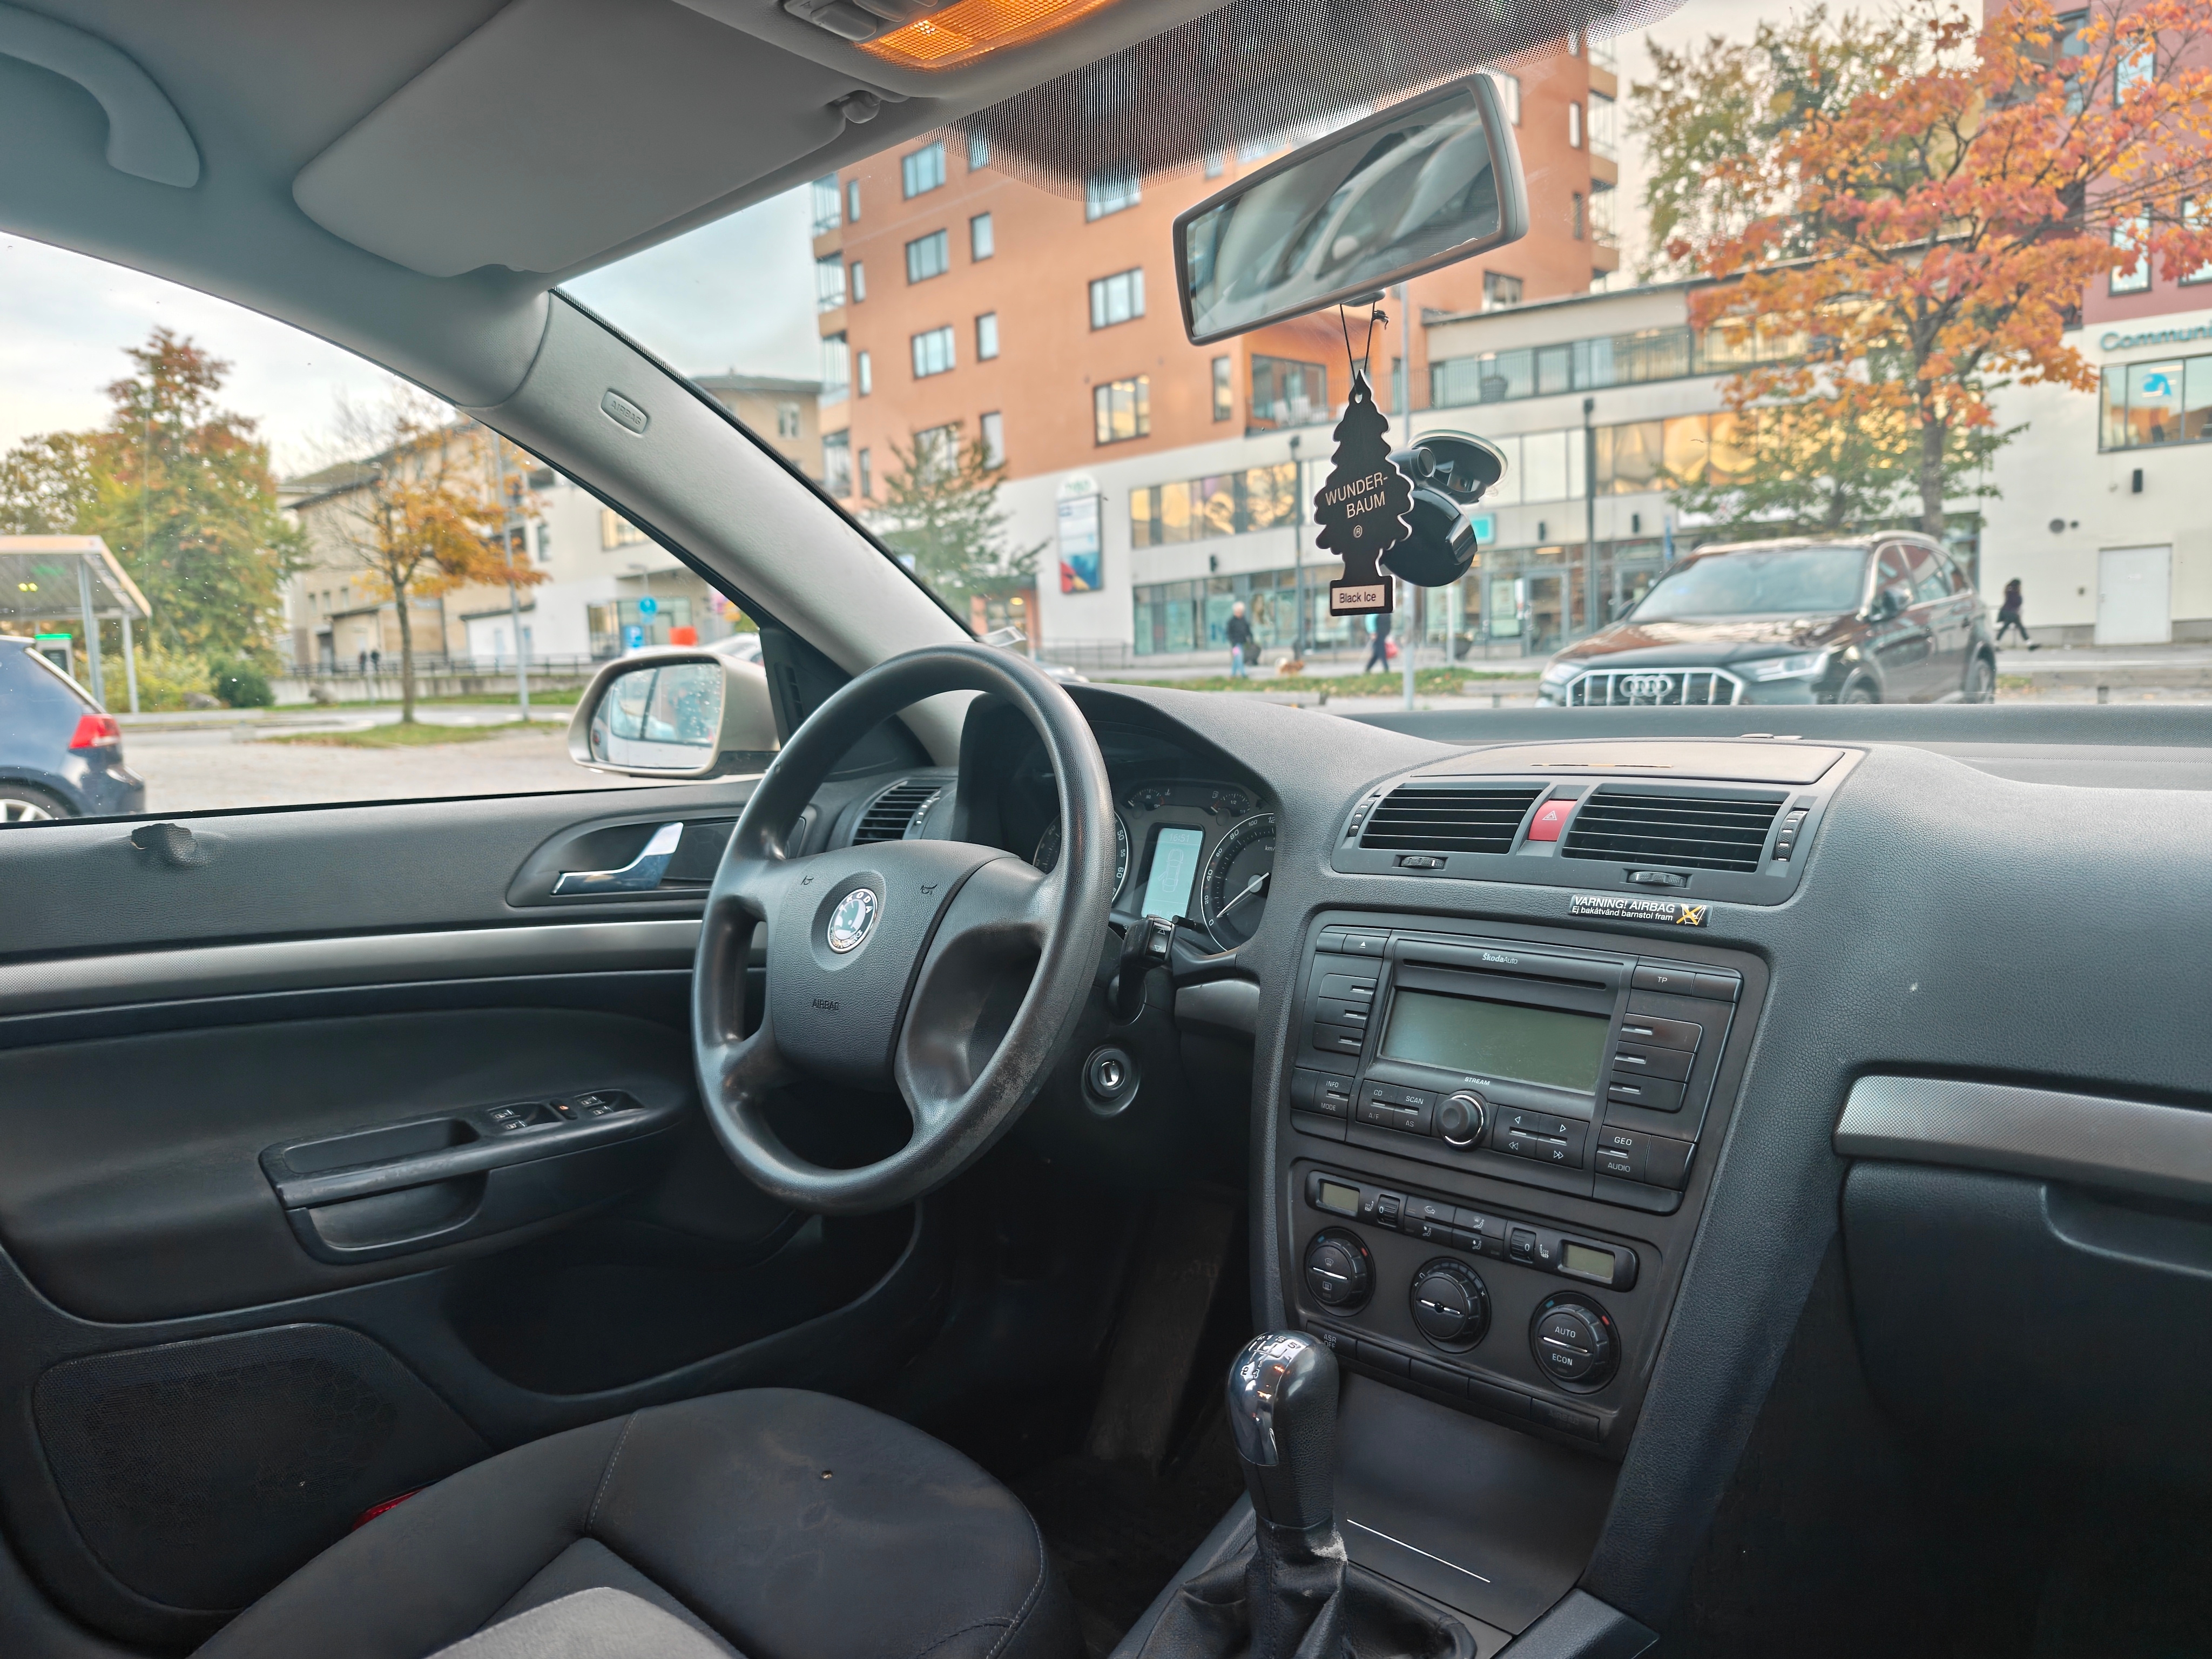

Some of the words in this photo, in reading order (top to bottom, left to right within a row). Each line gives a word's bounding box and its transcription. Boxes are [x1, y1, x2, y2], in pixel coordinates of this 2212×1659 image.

[612, 401, 642, 425] AIRBAG
[1325, 472, 1388, 505] WUNDER-
[1346, 491, 1385, 518] BAUM
[1339, 592, 1361, 603] Black
[1364, 591, 1376, 602] Ice
[1117, 830, 1124, 841] 50
[1170, 833, 1190, 842] 16:51
[1230, 829, 1239, 840] 80
[1121, 849, 1125, 858] 55
[1216, 848, 1223, 858] 60
[1116, 867, 1124, 879] 60
[1206, 869, 1213, 881] 40
[1204, 895, 1209, 905] 20
[1575, 896, 1627, 909] VARNING!
[1629, 900, 1675, 913] AIRBAG
[1572, 906, 1579, 914] Ej
[1580, 906, 1620, 916] bakåtvänd
[1621, 910, 1653, 919] barnstol
[1464, 1076, 1491, 1086] STREAM
[1405, 1095, 1424, 1104] SCAN
[1320, 1102, 1337, 1111] MODE
[1614, 1136, 1632, 1145] GEO
[1608, 1162, 1630, 1172] AUDIO
[1555, 1326, 1576, 1338] AUTO
[1324, 1334, 1336, 1343] ASR
[1552, 1353, 1573, 1366] ECON
